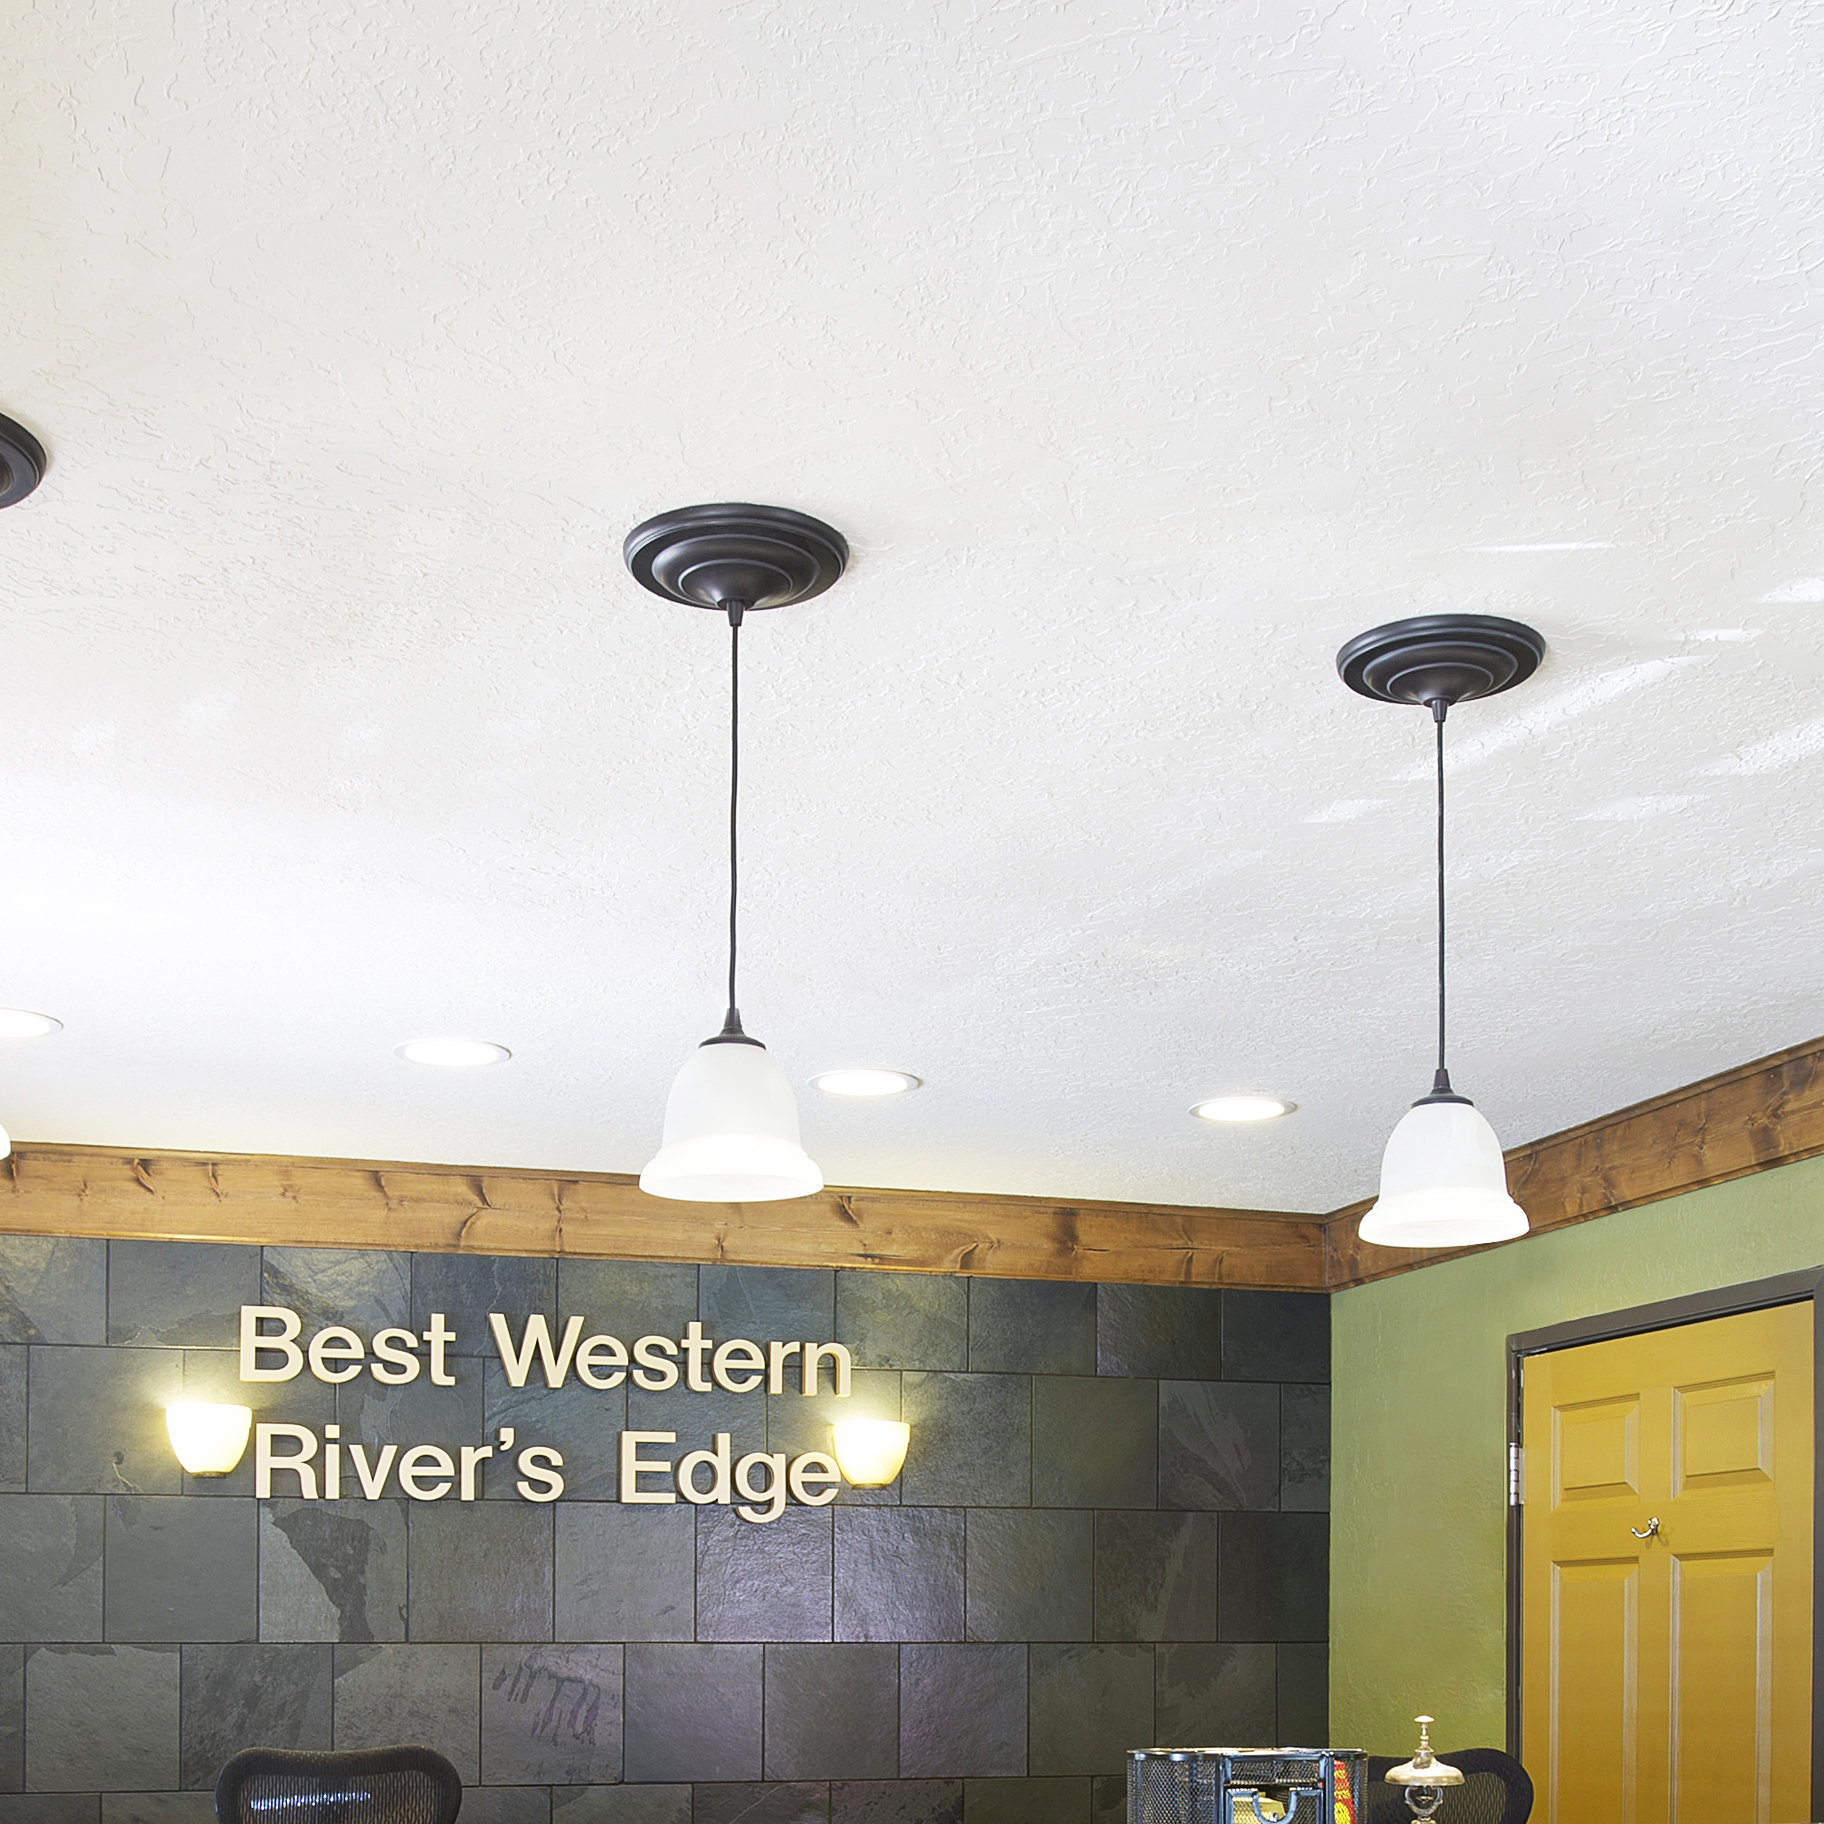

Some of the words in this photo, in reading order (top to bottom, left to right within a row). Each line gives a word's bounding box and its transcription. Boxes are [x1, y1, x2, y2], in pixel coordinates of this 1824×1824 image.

[238, 1304, 457, 1388] Best
[488, 1313, 852, 1397] Western
[254, 1423, 564, 1503] River's
[619, 1429, 842, 1524] Edge
